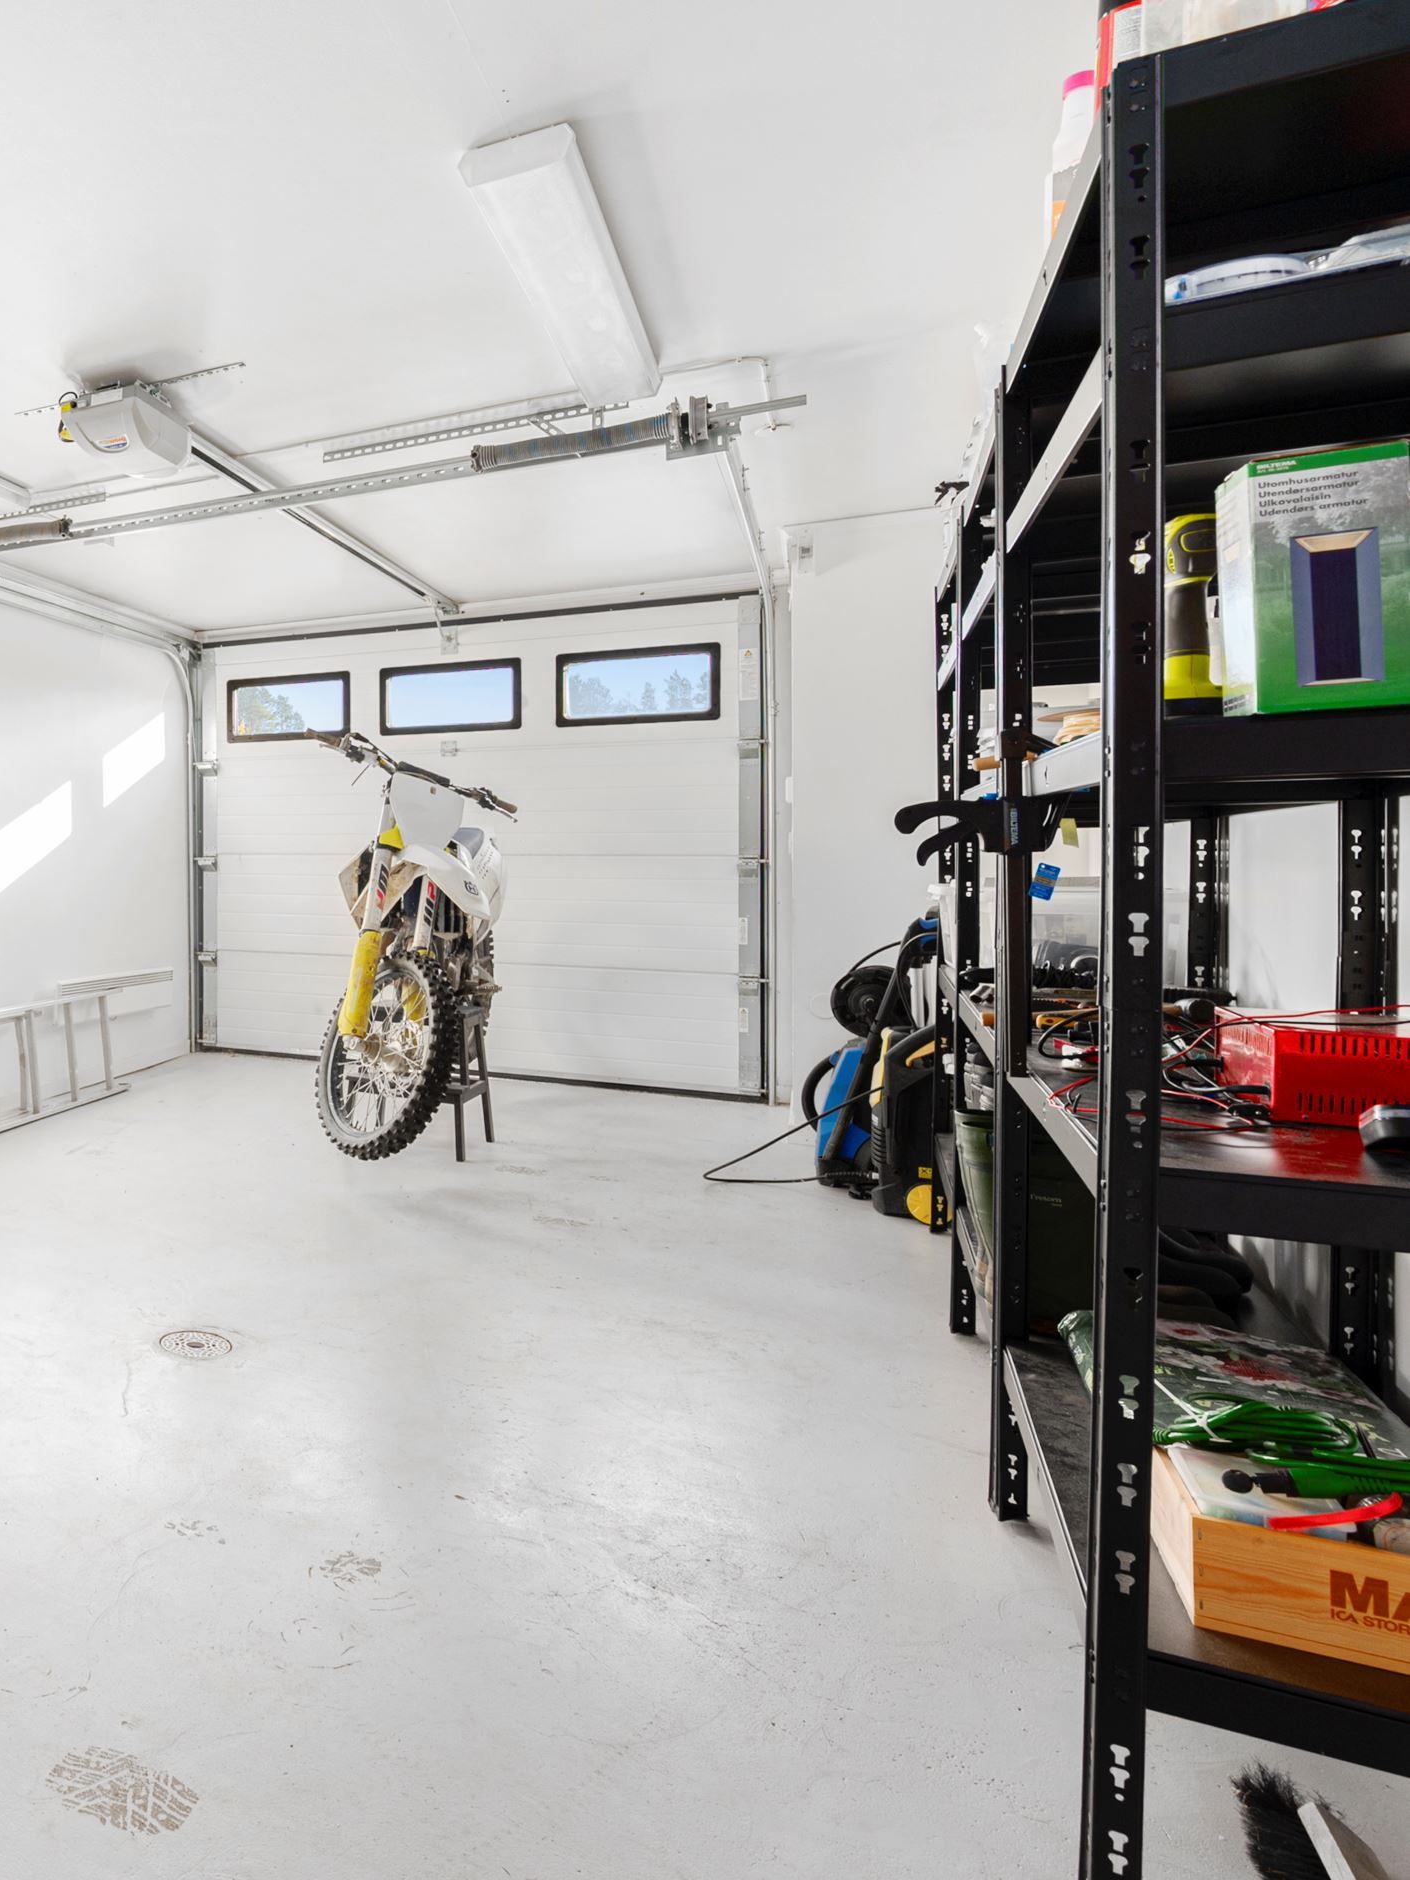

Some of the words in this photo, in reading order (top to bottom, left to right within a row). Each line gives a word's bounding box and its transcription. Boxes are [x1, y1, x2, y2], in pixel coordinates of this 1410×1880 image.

[1258, 471, 1359, 489] Utomhusarmatur
[1258, 480, 1360, 498] Utendørsarmatur
[1259, 492, 1331, 508] Ulkovalaisin
[1259, 505, 1315, 517] Udendørs
[1319, 498, 1369, 510] armatur
[1330, 1608, 1359, 1625] ICA
